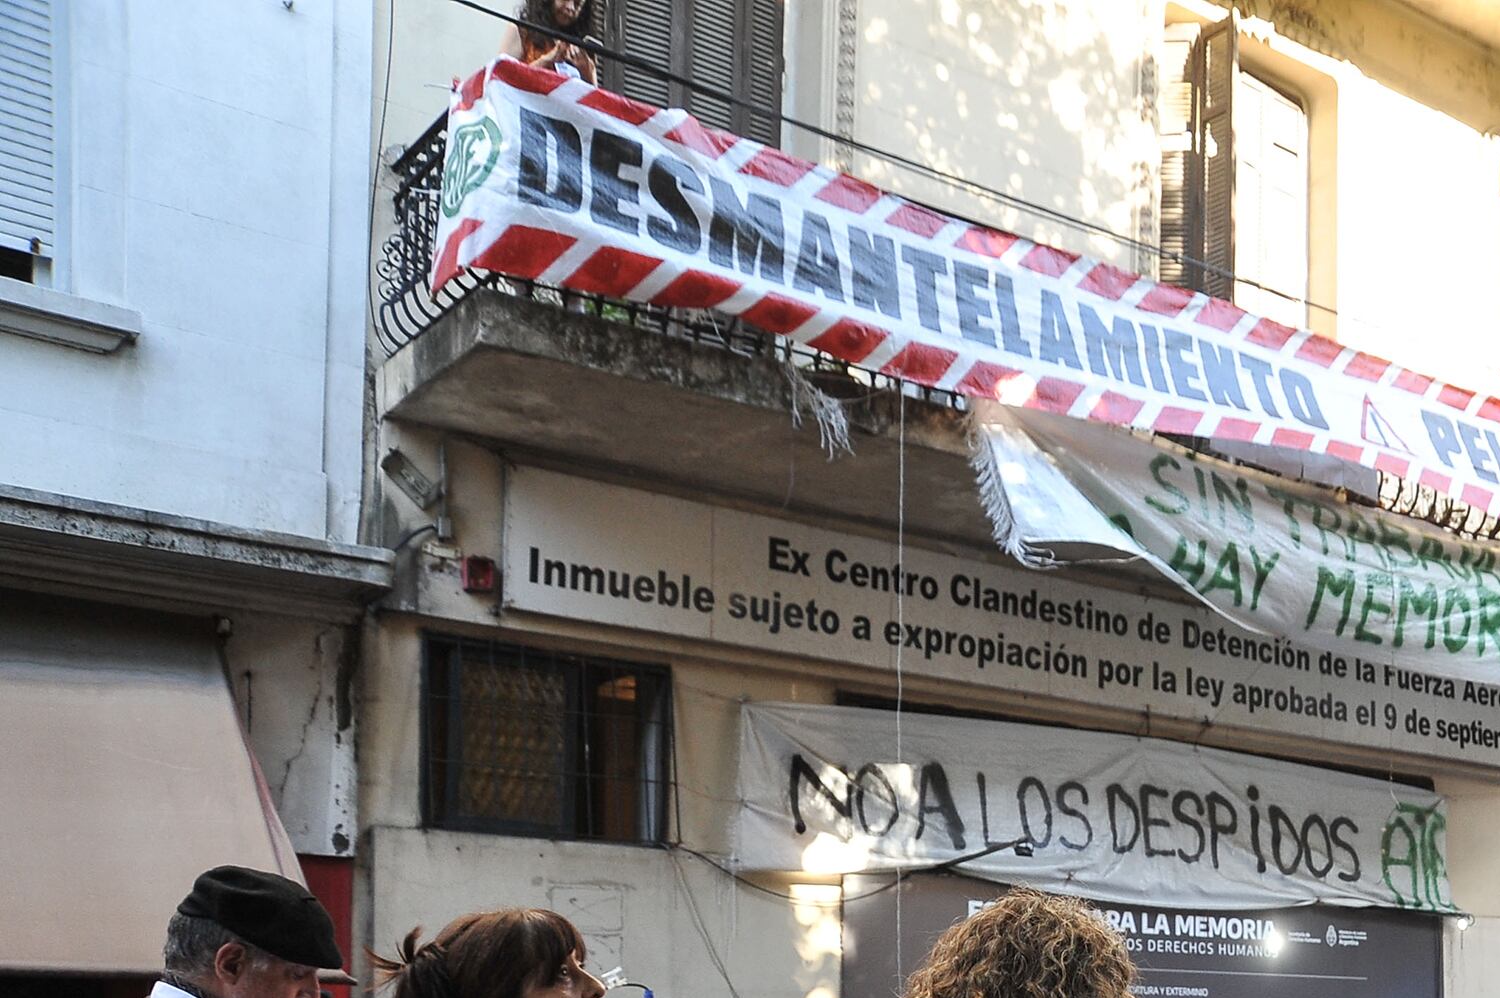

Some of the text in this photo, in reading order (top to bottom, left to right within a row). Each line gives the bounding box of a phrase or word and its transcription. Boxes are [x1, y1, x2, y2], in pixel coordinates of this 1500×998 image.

[515, 106, 1330, 432] DESMANTELAMIENTO
[1144, 455, 1256, 532] SIN
[1170, 534, 1281, 611] HAY
[528, 546, 716, 613] Inmueble
[727, 591, 841, 635] sujeto
[851, 614, 872, 641] a
[884, 618, 1088, 679] expropiación
[1097, 658, 1144, 690] por
[1152, 661, 1177, 694] la
[1186, 667, 1224, 708] ley
[1232, 681, 1348, 724] aprobada
[1356, 700, 1376, 728] el
[1384, 703, 1398, 731] 9
[1404, 708, 1431, 738] de
[767, 536, 811, 578] Ex
[824, 549, 940, 601] Centro
[950, 573, 1129, 637] Clandestino
[1137, 611, 1172, 645] de
[1182, 618, 1312, 673] Detención
[1318, 651, 1348, 679] de
[1355, 658, 1376, 684] la
[1383, 665, 1456, 700] Fuerza
[789, 752, 899, 840] NO
[916, 761, 967, 851] A
[977, 771, 1093, 853] LOS
[1105, 782, 1362, 883] DESPIDOS
[1141, 911, 1172, 936] LA
[1174, 914, 1278, 942] MEMORIA
[1147, 939, 1215, 956] DERECHOS
[1159, 986, 1167, 997] Y
[1166, 986, 1209, 998] EXTERMINIO
